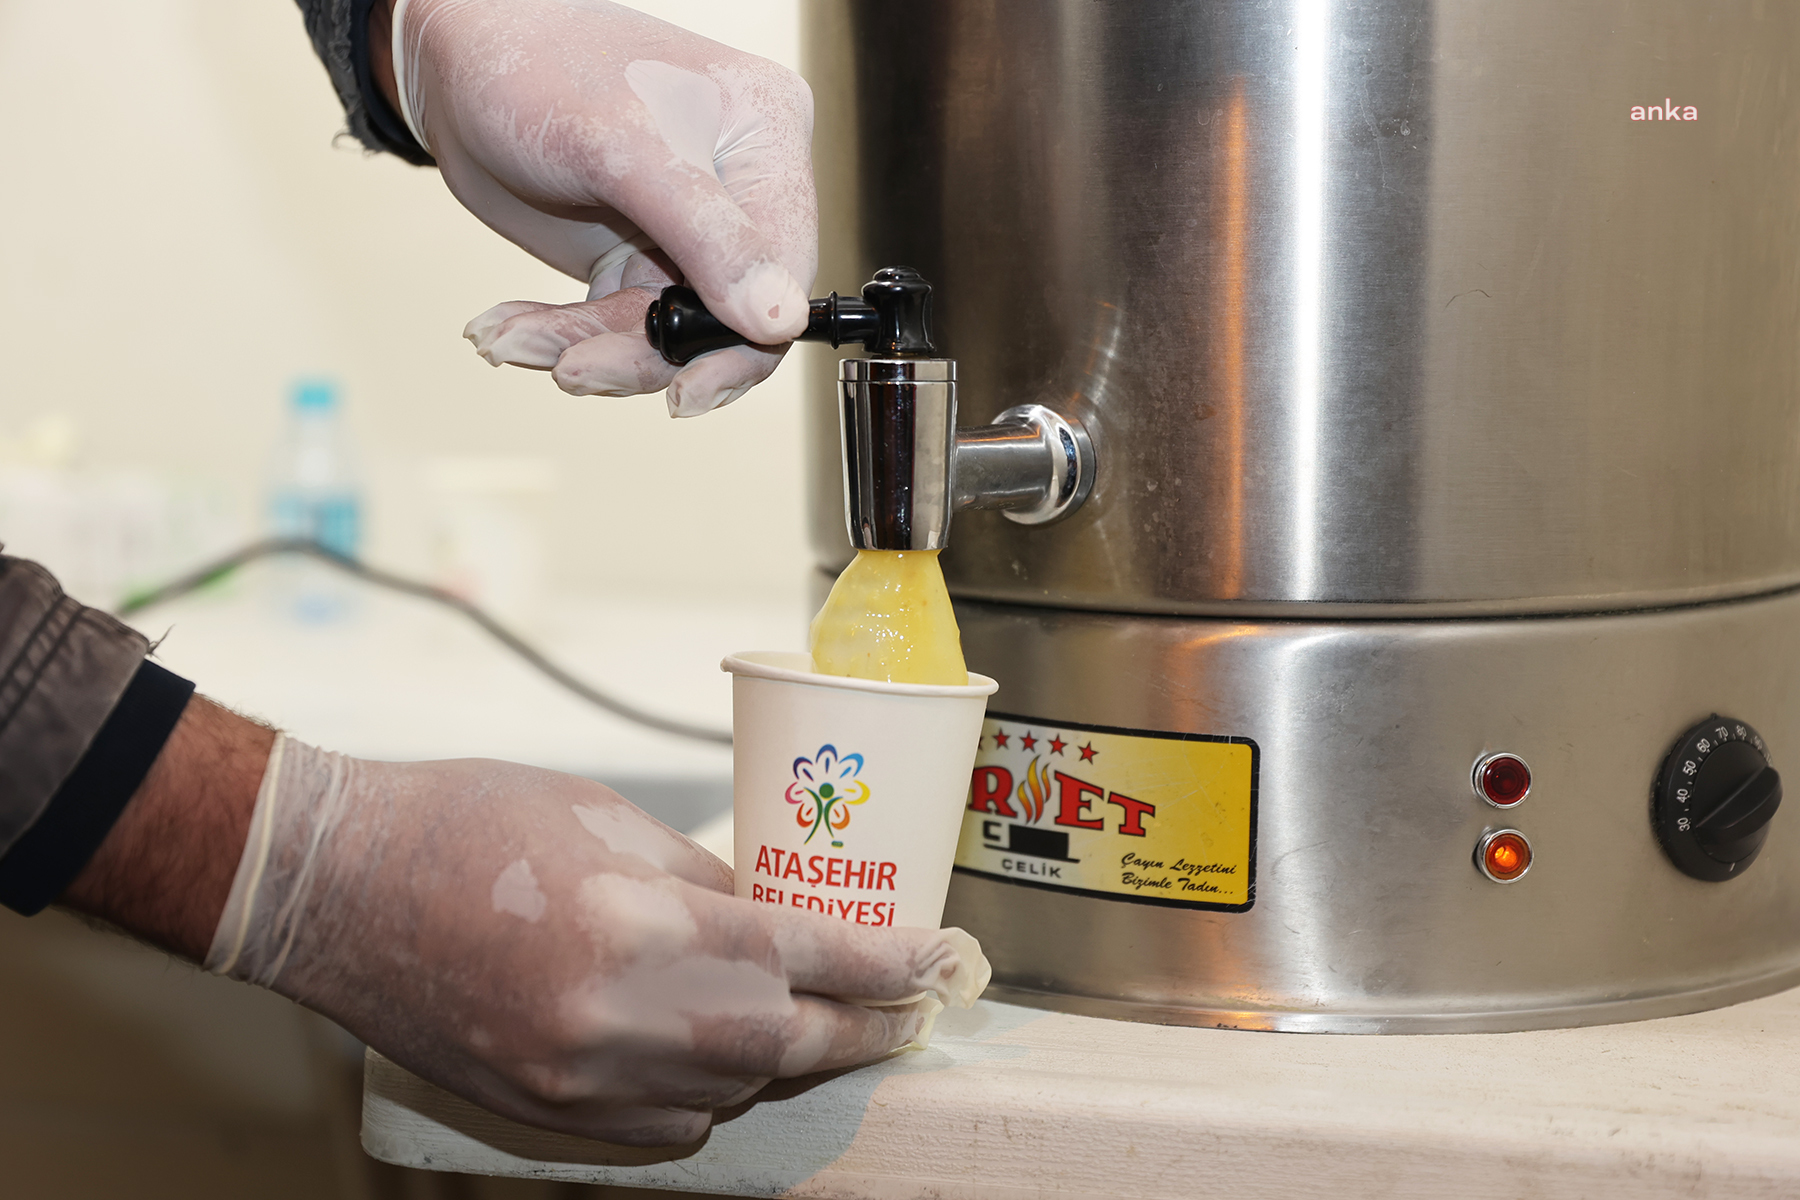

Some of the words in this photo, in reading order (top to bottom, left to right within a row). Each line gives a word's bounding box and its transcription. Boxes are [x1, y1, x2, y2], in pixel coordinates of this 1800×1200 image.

[1715, 726, 1729, 739] 70
[1696, 738, 1710, 753] 60
[1683, 760, 1696, 776] 50
[1676, 788, 1688, 803] 40
[1677, 817, 1690, 832] 30
[755, 845, 897, 891] ATAŞEHİR
[1001, 858, 1062, 879] ÇELİK
[1121, 852, 1165, 871] Çayın
[1169, 858, 1237, 877] Lezzetini
[1121, 872, 1173, 890] Bizimle
